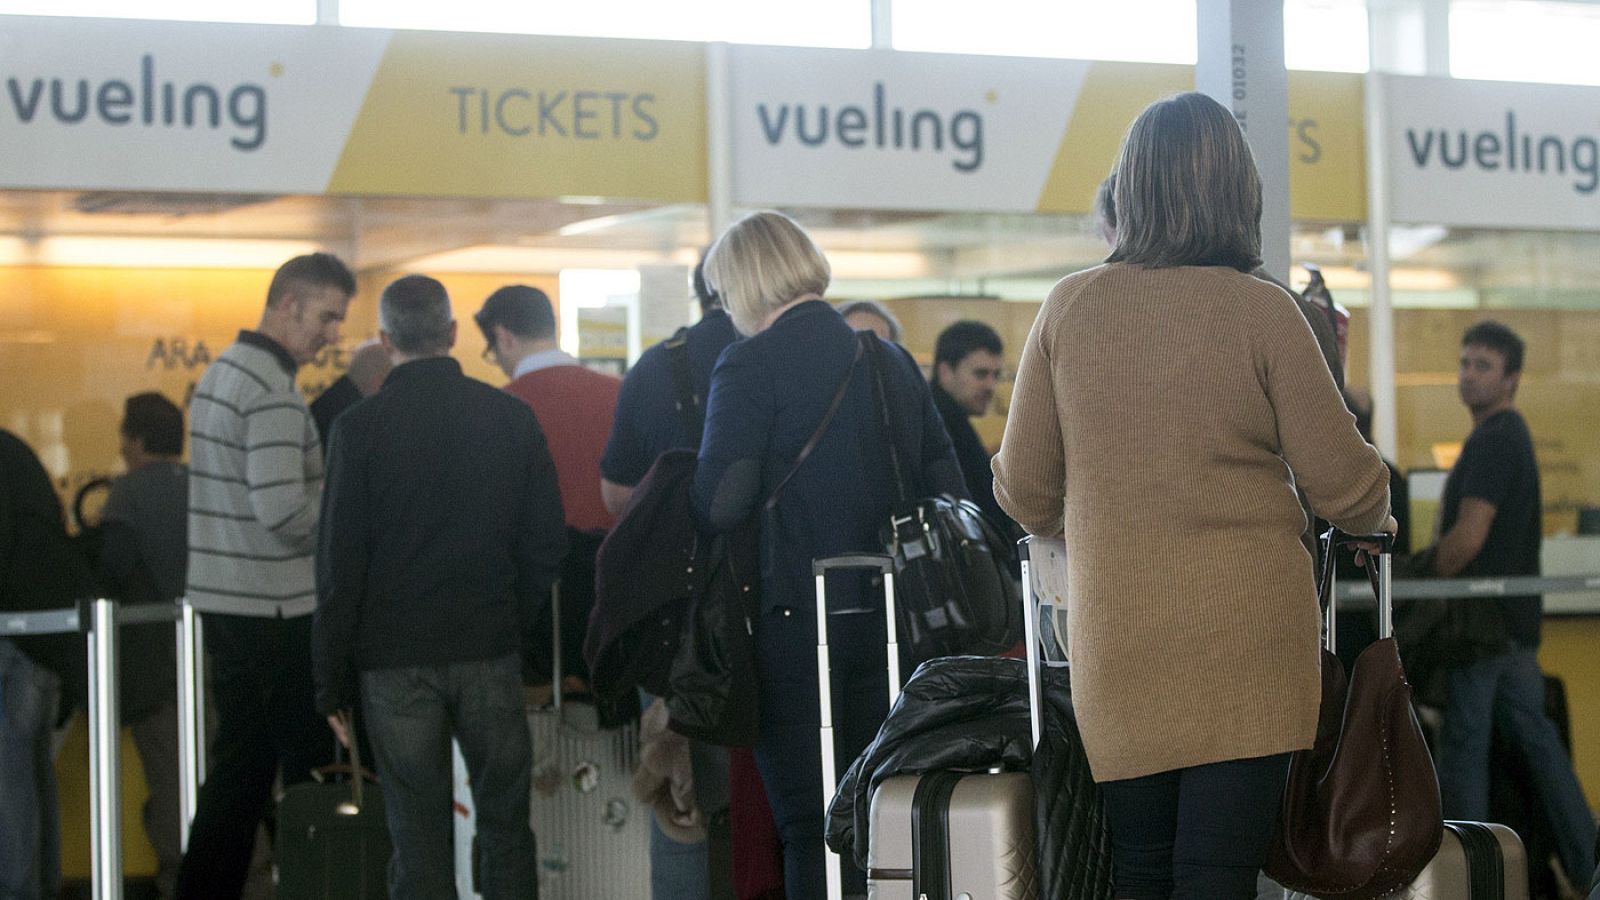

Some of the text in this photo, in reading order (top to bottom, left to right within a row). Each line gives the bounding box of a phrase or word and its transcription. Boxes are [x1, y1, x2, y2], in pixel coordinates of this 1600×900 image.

[6, 54, 268, 153] vueling
[449, 86, 660, 140] TICKETS
[757, 81, 985, 174] vueling
[1405, 111, 1600, 195] vueling
